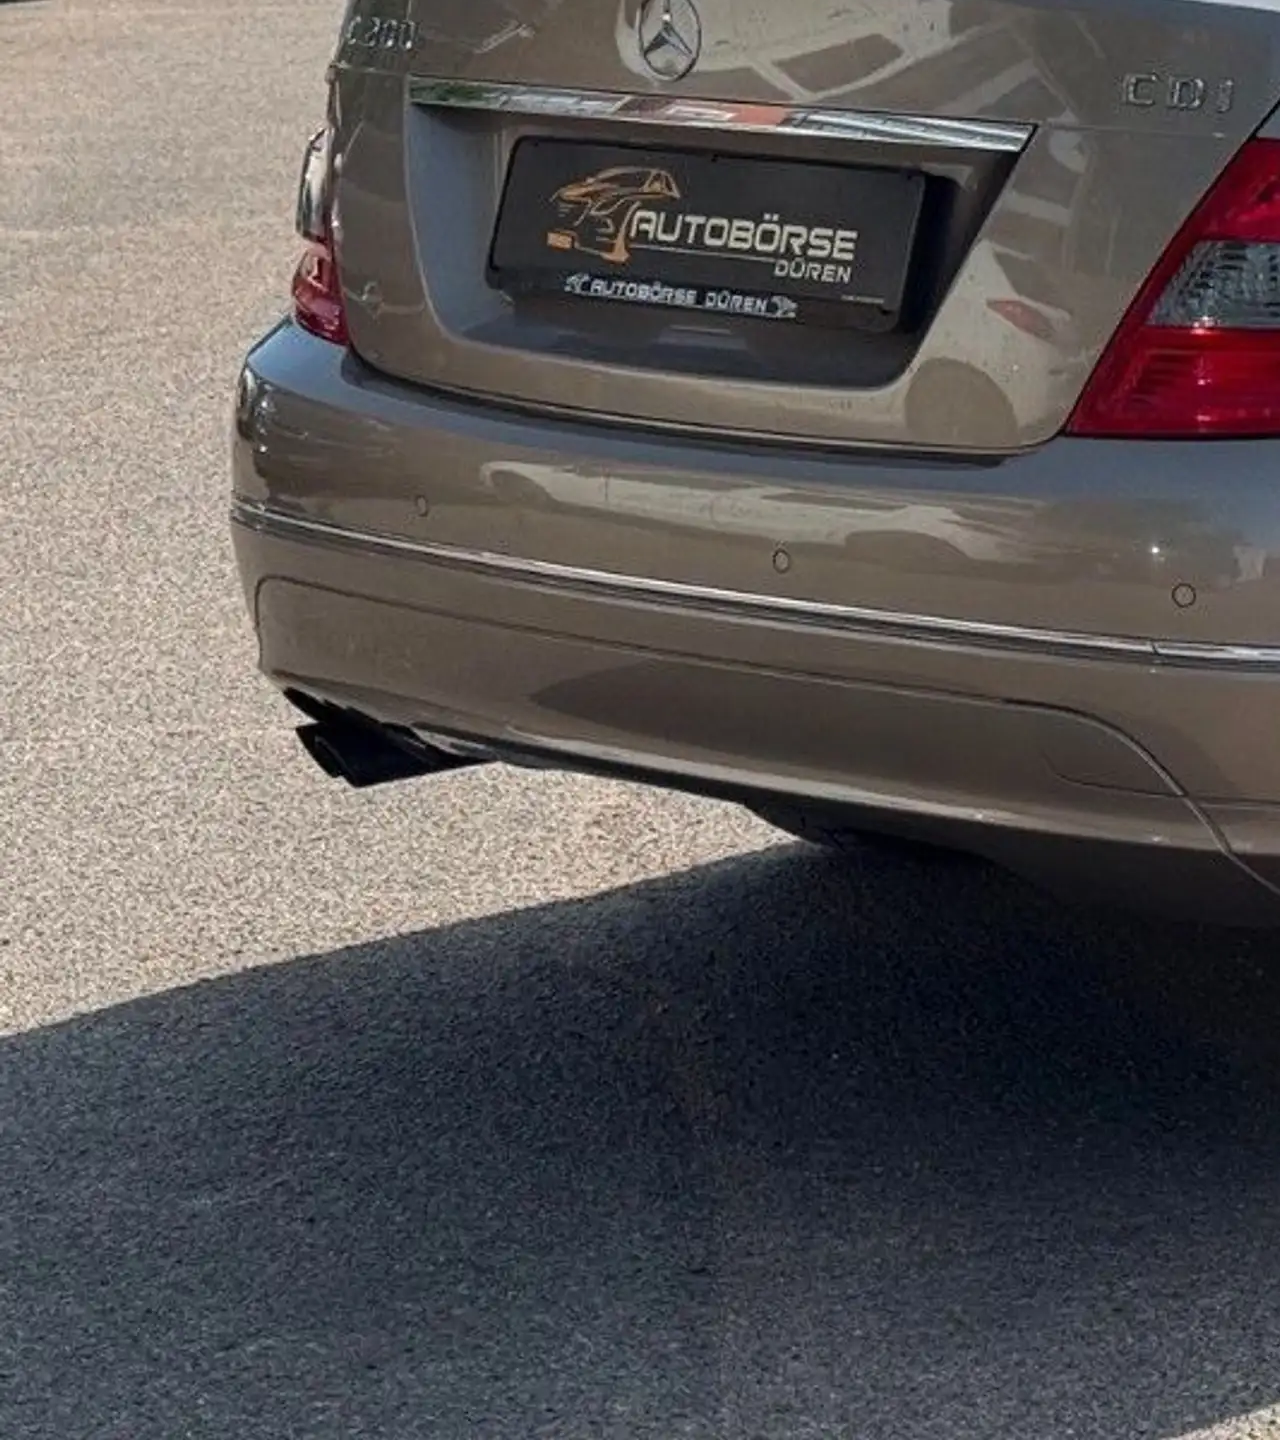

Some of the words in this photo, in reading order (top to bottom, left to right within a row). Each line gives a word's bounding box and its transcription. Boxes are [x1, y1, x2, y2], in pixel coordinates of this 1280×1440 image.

[629, 210, 858, 261] AUTOBÖRSE
[773, 256, 852, 284] DÜREN
[590, 276, 697, 303] AUTOBÖRSE
[705, 291, 769, 313] DÜREN
